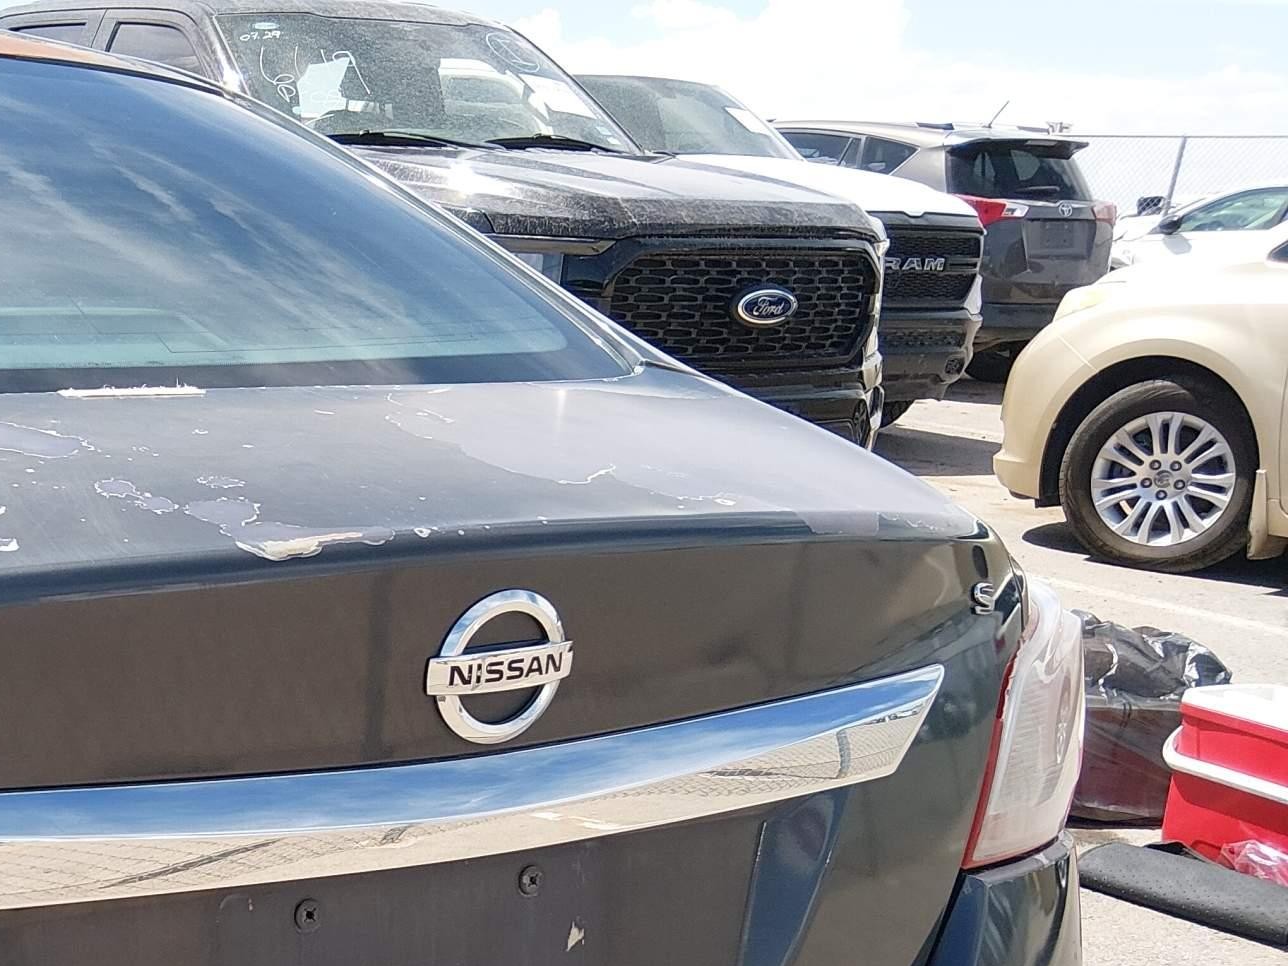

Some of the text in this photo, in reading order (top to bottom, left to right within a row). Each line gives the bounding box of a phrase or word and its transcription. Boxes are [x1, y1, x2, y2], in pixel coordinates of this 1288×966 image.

[884, 256, 945, 271] RAM
[753, 296, 785, 316] Ford
[448, 651, 563, 687] NISSAN
